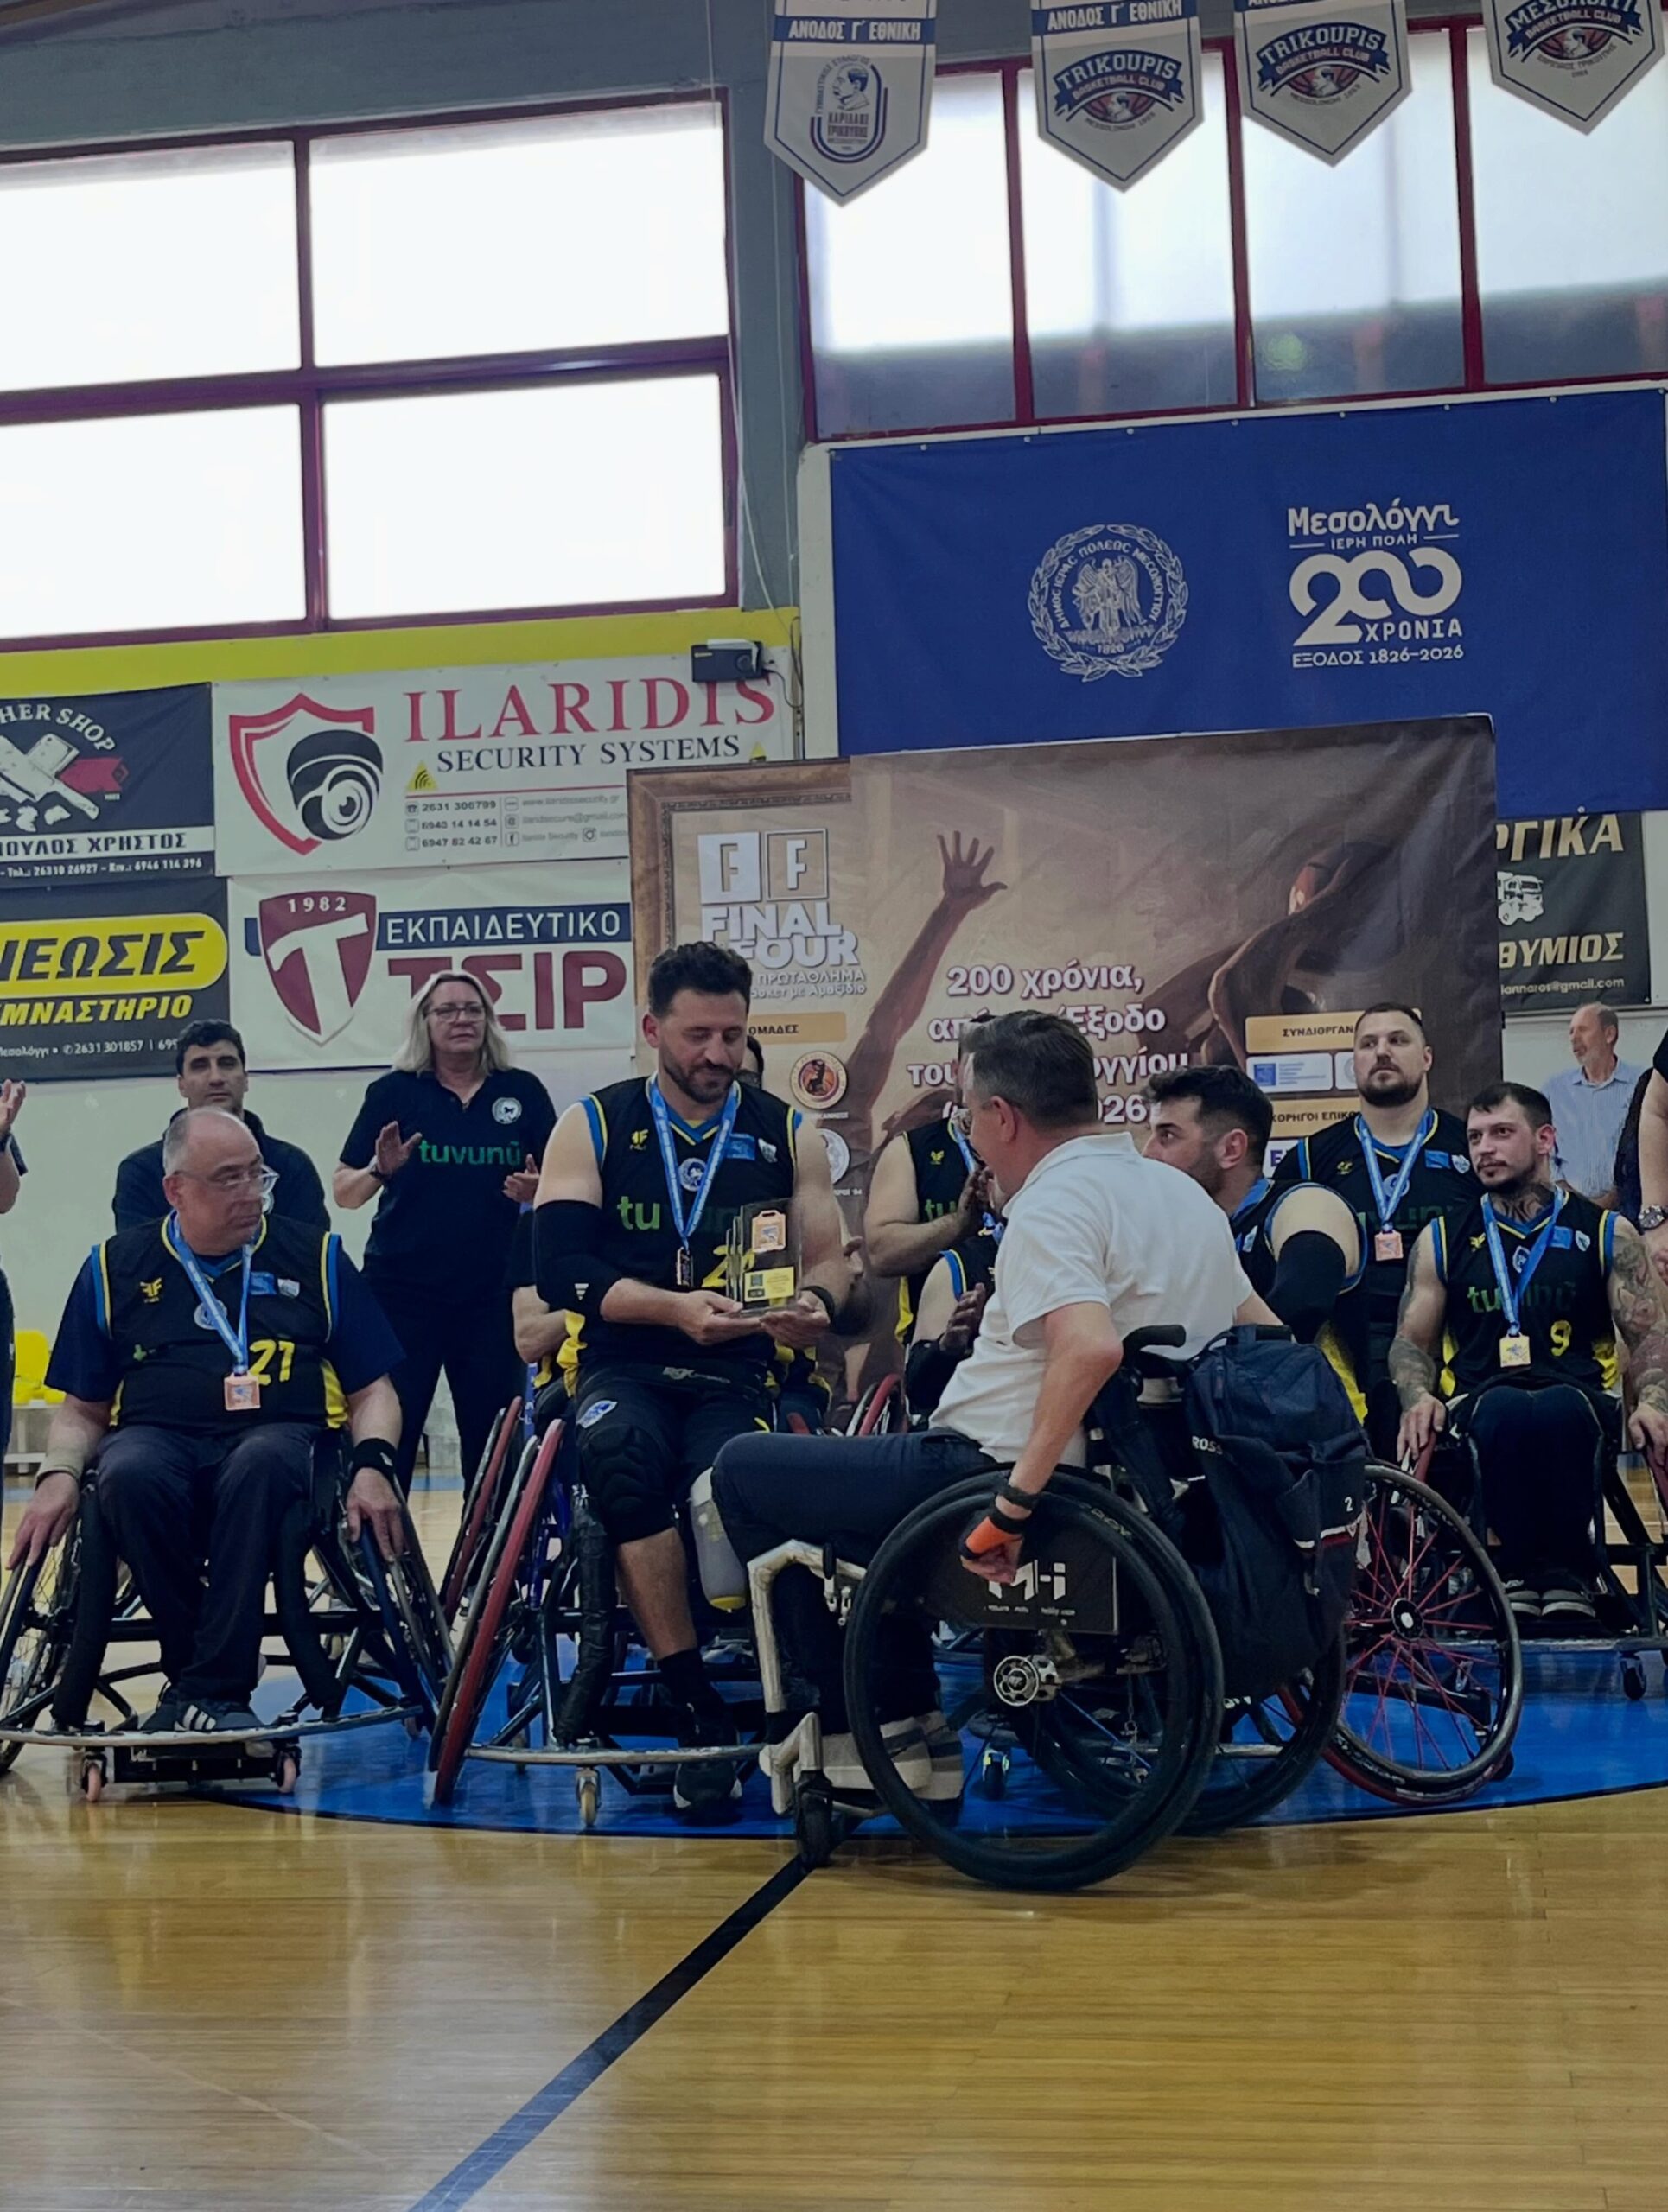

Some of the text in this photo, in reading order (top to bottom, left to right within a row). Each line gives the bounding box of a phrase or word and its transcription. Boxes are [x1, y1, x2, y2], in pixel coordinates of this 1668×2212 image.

[788, 20, 845, 40] ΑΝΟΔΟΣ
[869, 22, 921, 41] ΕΘΝΙΚΗ
[1047, 7, 1104, 31] ΑΝΟΔΟΣ
[1130, 0, 1182, 22] ΕΘΝΙΚΗ
[1260, 27, 1381, 65] TRIKOUPIS
[1057, 54, 1177, 90] TRIKOUPIS
[1288, 498, 1460, 537] Μεσολόγγι
[1331, 534, 1417, 550] ΙΕΡΗ ΠΟΛΗ
[1289, 547, 1462, 646] 200
[1365, 618, 1463, 643] ΧΡΟΝΙΑ
[1293, 651, 1364, 668] ΕΞΟΔΟΣ
[404, 674, 774, 742] ILARIDIS
[56, 707, 116, 751] SHOP
[437, 734, 740, 772] SECURITY SYSTEMS
[0, 832, 187, 857] ΟΥΛΟΣ ΧΡΗΣΤΟΣ
[287, 897, 347, 913] 1982
[701, 901, 844, 943] FINAL
[386, 910, 621, 944] ΕΚΠΑΙΔΕΥΤΙΚΟ
[730, 930, 860, 970] FOUR
[947, 959, 1144, 998] 200 χρόνια,
[0, 995, 194, 1026] ΜΝΑΣΤΗΡΙΟ
[74, 1041, 100, 1054] 2631
[104, 1039, 143, 1053] 301857
[748, 1024, 799, 1036] ΟΜΑΔΕΣ
[1550, 1320, 1572, 1357] 9
[248, 1339, 296, 1386] 21
